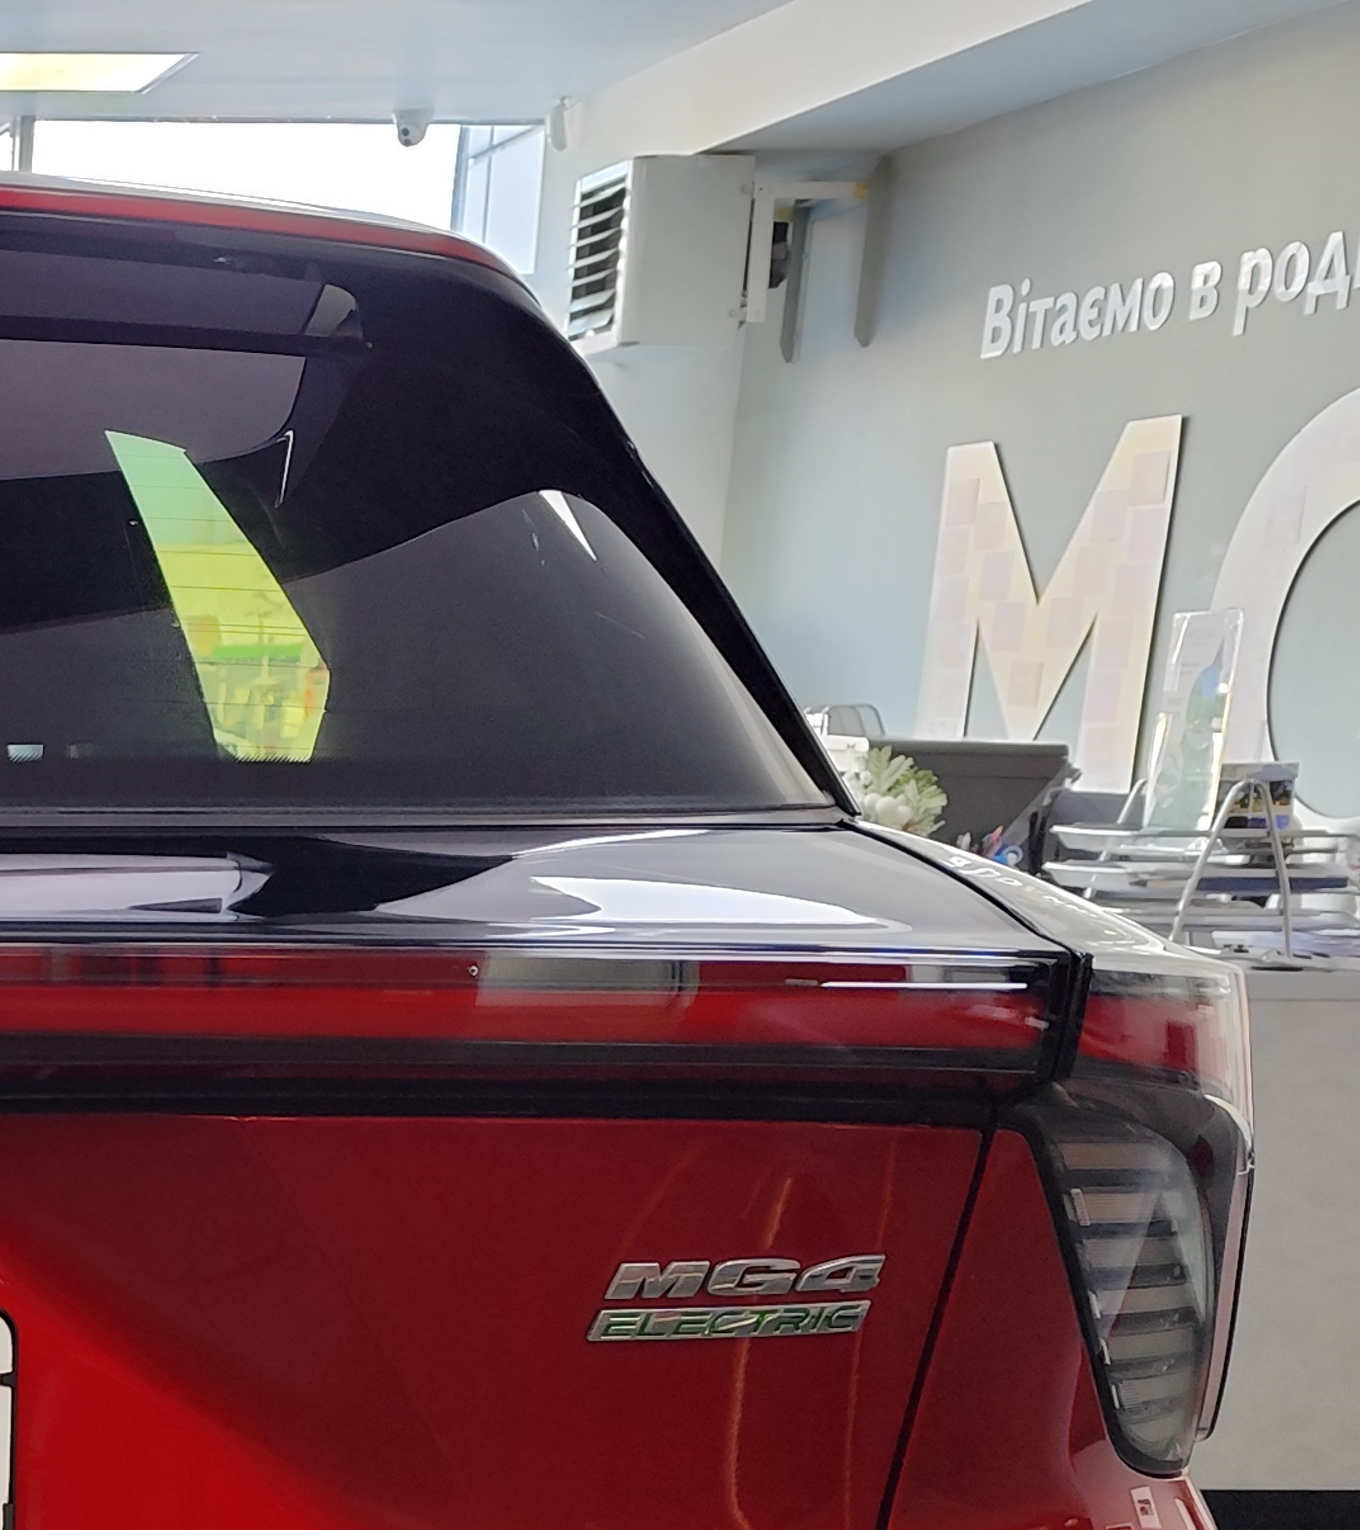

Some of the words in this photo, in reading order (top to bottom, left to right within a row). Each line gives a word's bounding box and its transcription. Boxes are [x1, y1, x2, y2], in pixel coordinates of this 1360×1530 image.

[980, 270, 1175, 360] Вітаємо
[1189, 260, 1222, 320] в
[1233, 230, 1360, 336] род
[604, 1254, 886, 1300] MG4
[594, 1301, 868, 1339] ELECTRIC
